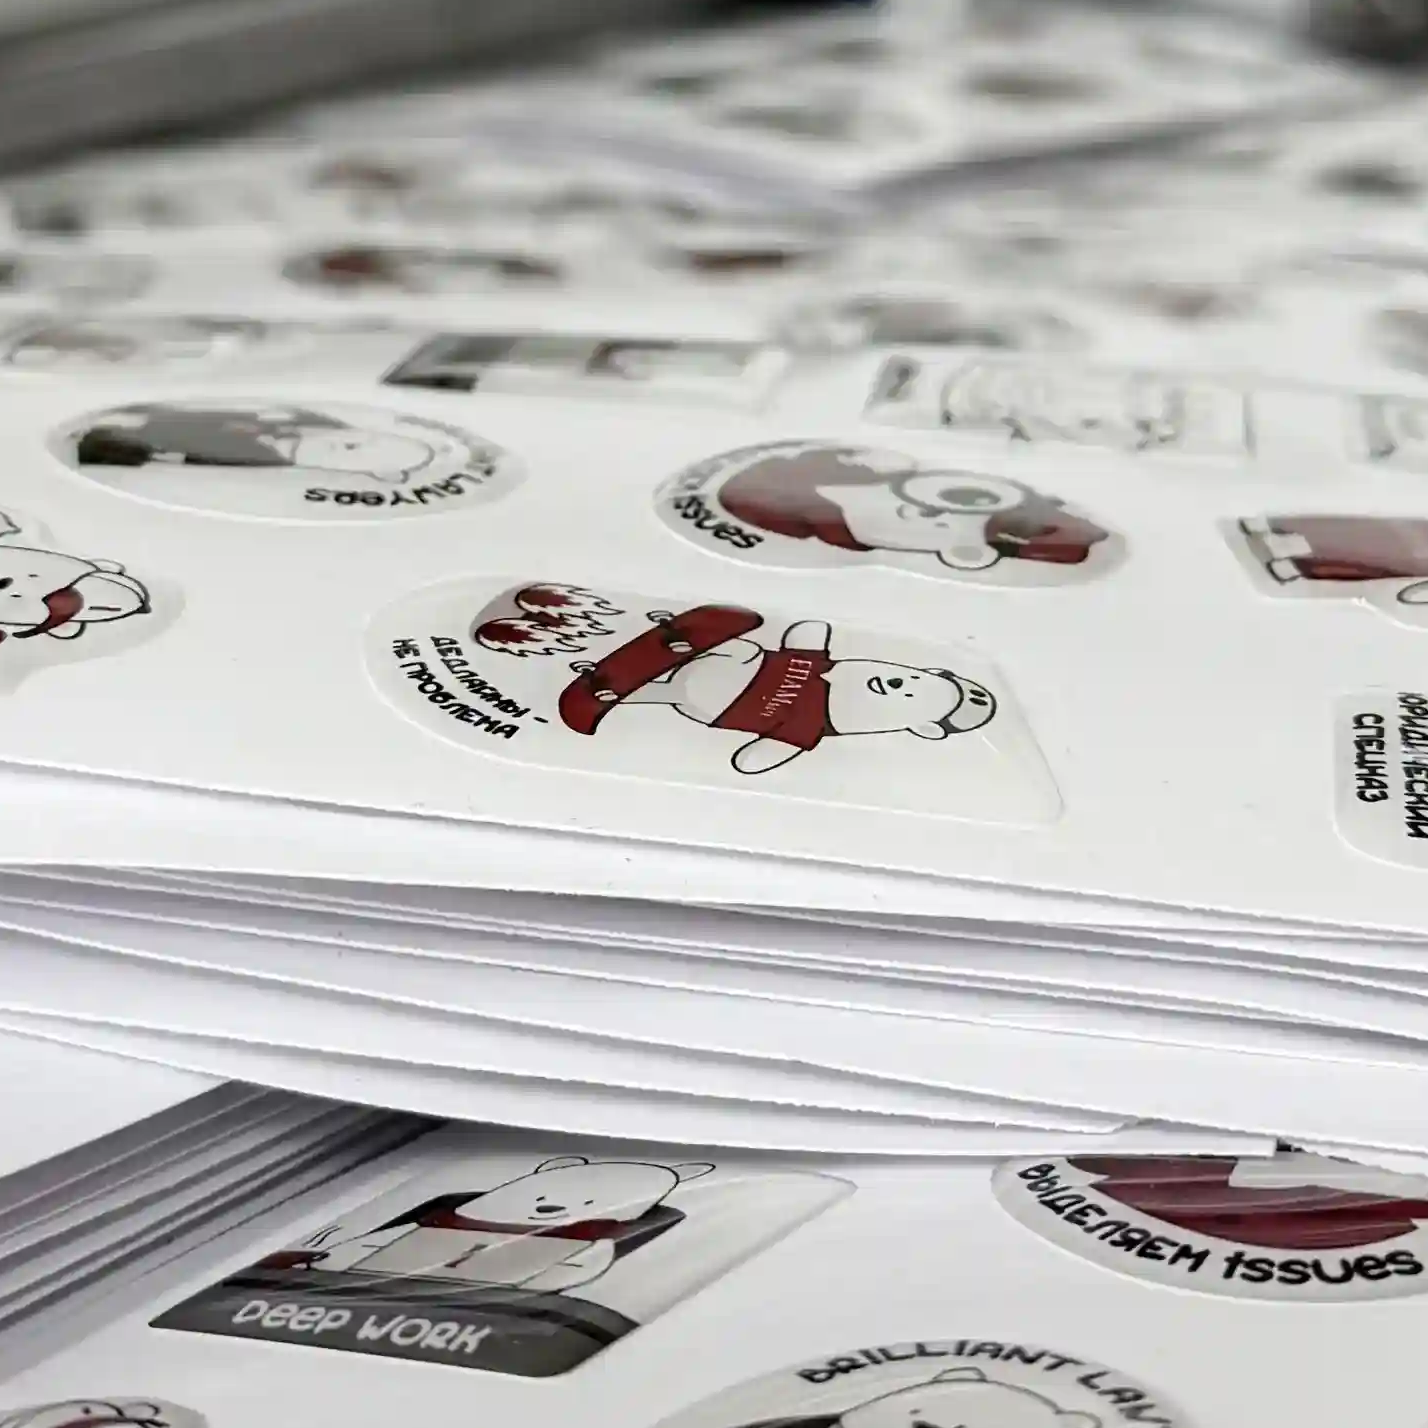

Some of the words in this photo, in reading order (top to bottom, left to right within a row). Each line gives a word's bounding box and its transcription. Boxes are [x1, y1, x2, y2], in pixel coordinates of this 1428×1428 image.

[392, 637, 421, 659] НЕ
[399, 661, 520, 740] ПРОБЛЕМА
[1352, 713, 1390, 803] СПЕЦНАЗ
[1017, 1162, 1212, 1273] ВЫДЕЛЯЕМ
[356, 1314, 493, 1354] WORK
[798, 1339, 1085, 1384] BRILLIANT
